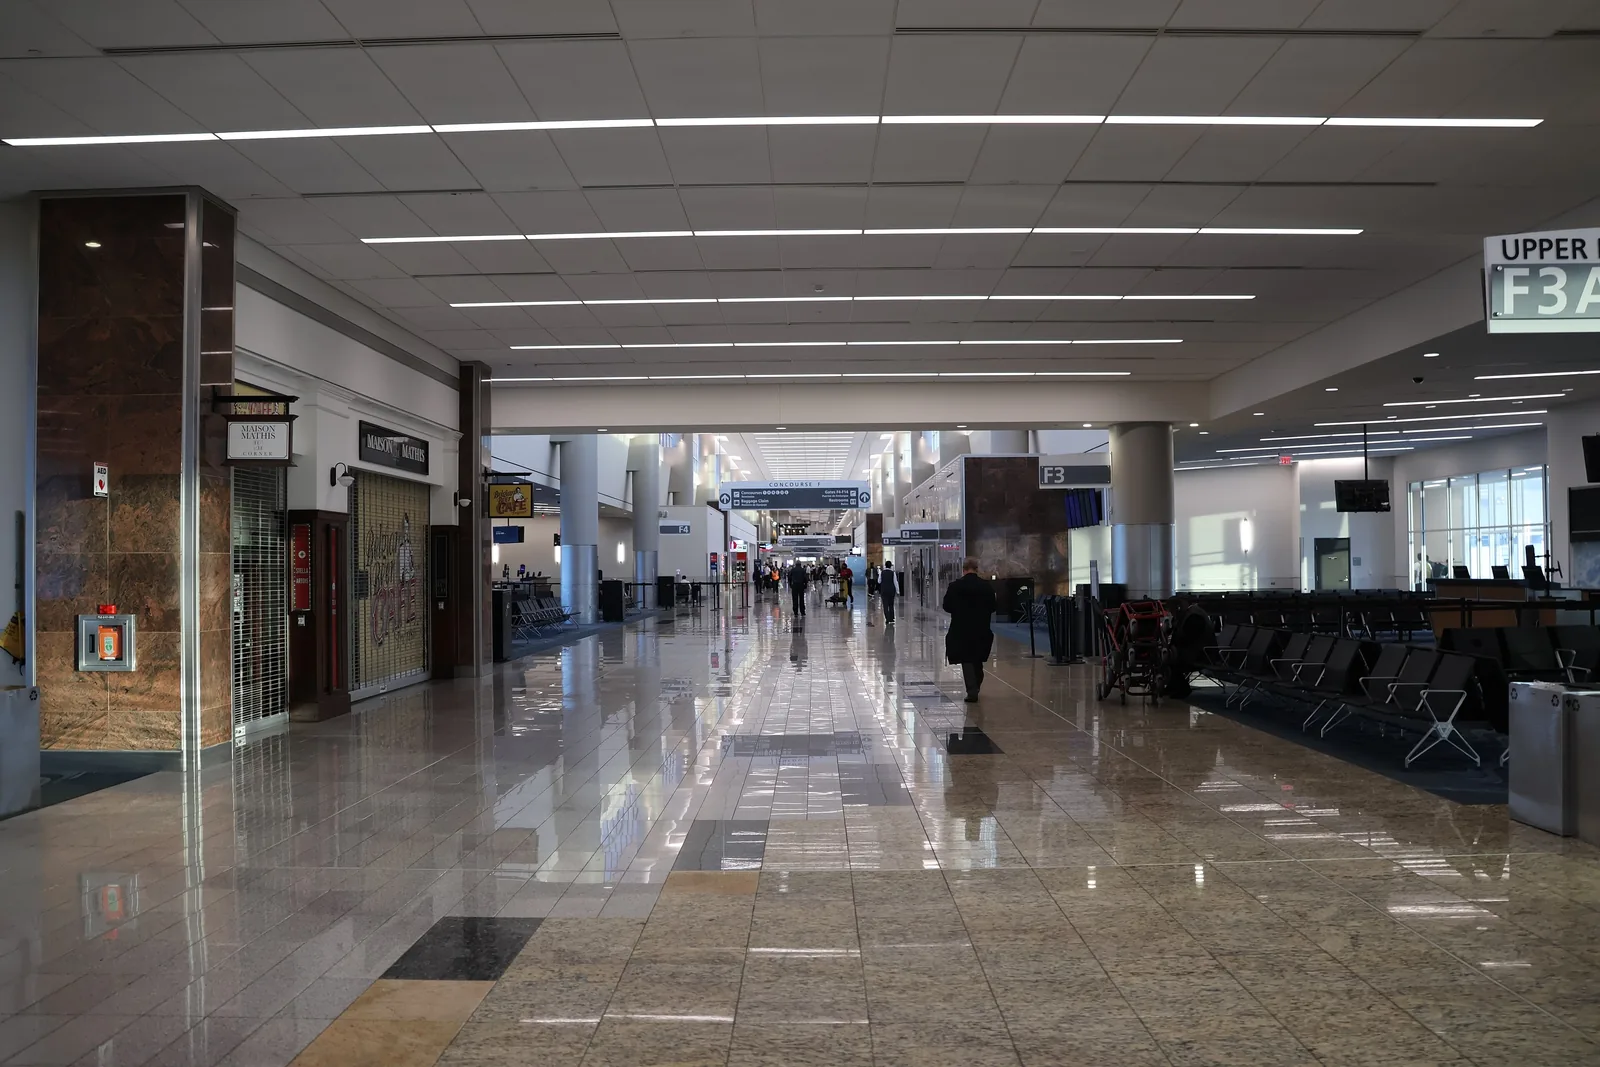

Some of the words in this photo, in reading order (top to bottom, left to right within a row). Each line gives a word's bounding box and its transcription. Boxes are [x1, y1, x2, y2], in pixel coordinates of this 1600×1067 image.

[1502, 238, 1588, 260] UPPER
[367, 434, 393, 454] MAISON
[401, 443, 425, 463] MATHIS
[97, 467, 107, 475] AED
[1044, 467, 1065, 483] F3
